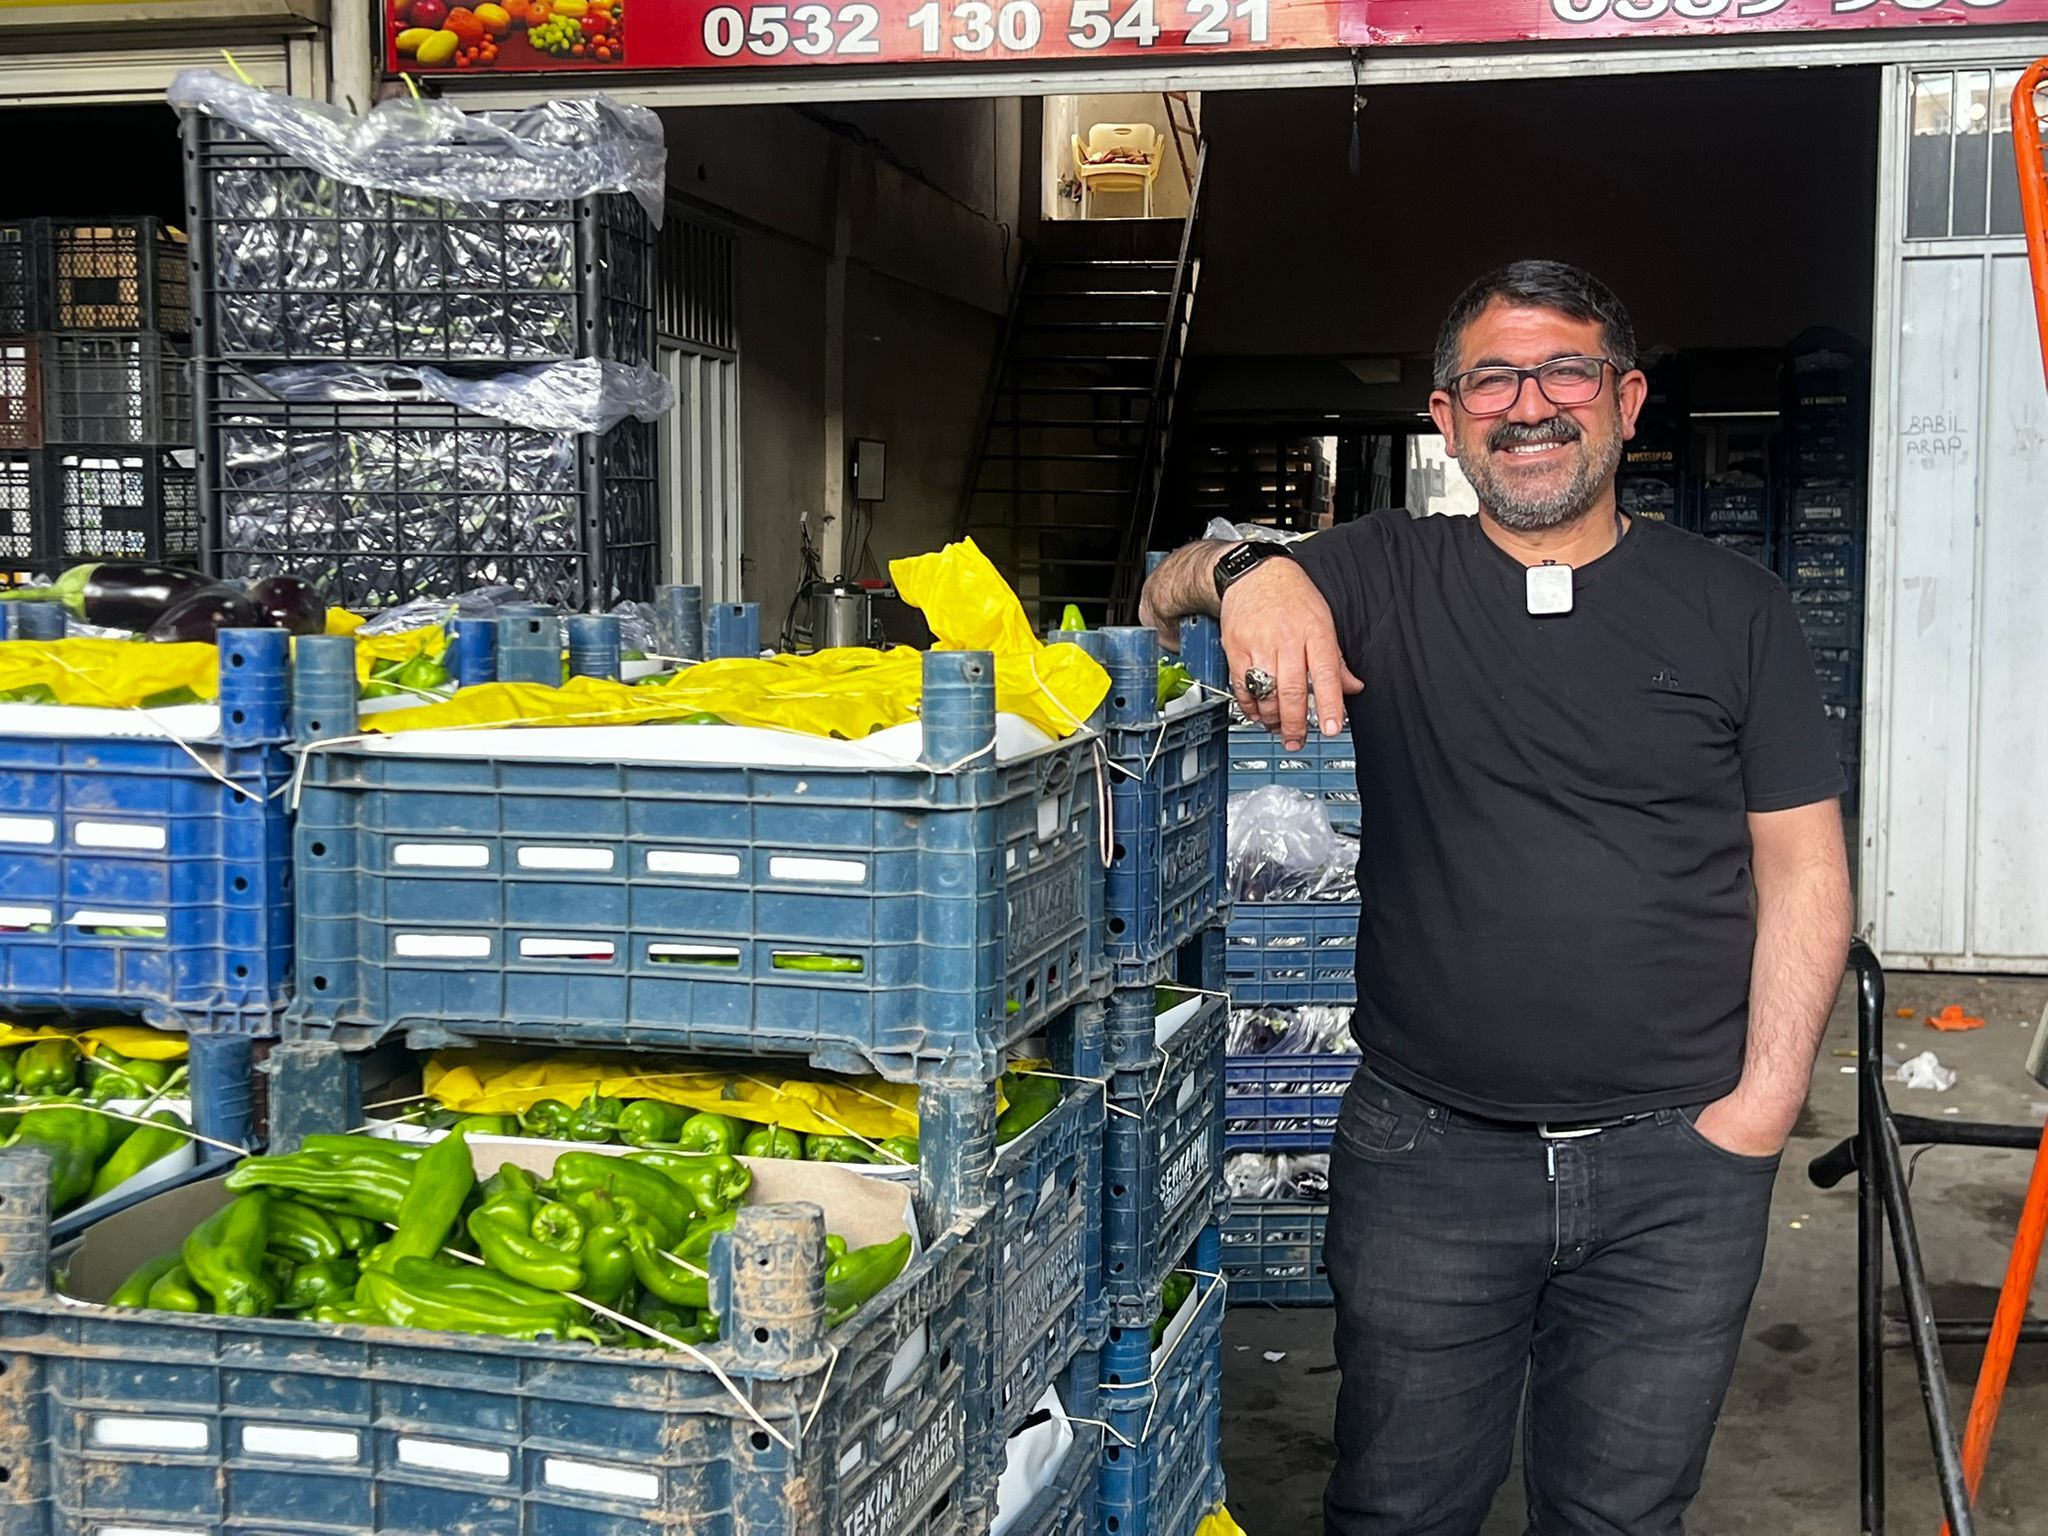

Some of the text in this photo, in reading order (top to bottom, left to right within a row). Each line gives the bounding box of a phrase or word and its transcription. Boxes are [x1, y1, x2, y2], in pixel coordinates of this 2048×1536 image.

[703, 0, 1269, 57] 0532 130 54 21
